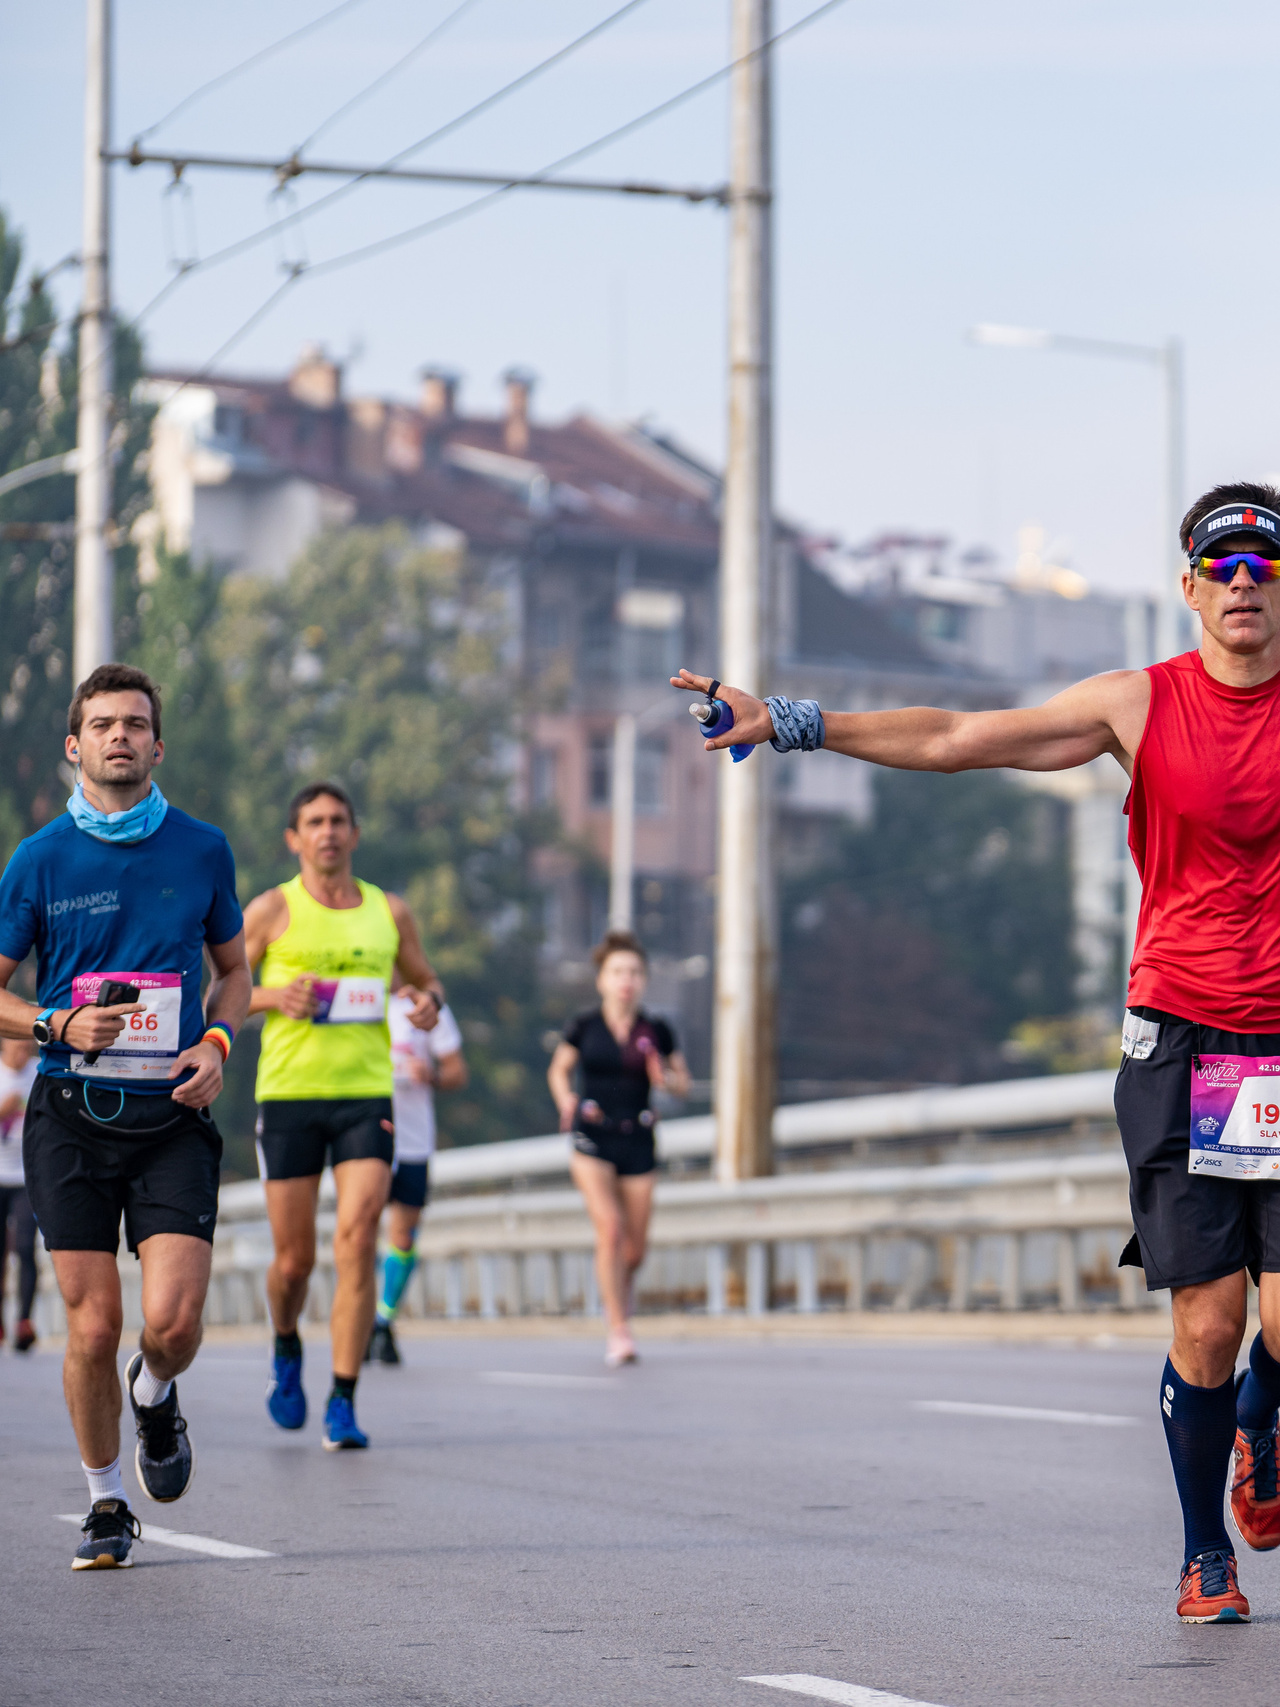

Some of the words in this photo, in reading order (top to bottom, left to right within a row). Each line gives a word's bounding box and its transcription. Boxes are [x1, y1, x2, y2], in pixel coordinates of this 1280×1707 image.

[1207, 509, 1276, 533] IRONMAN
[129, 1012, 158, 1031] 66
[1203, 1143, 1220, 1151] WIZZ
